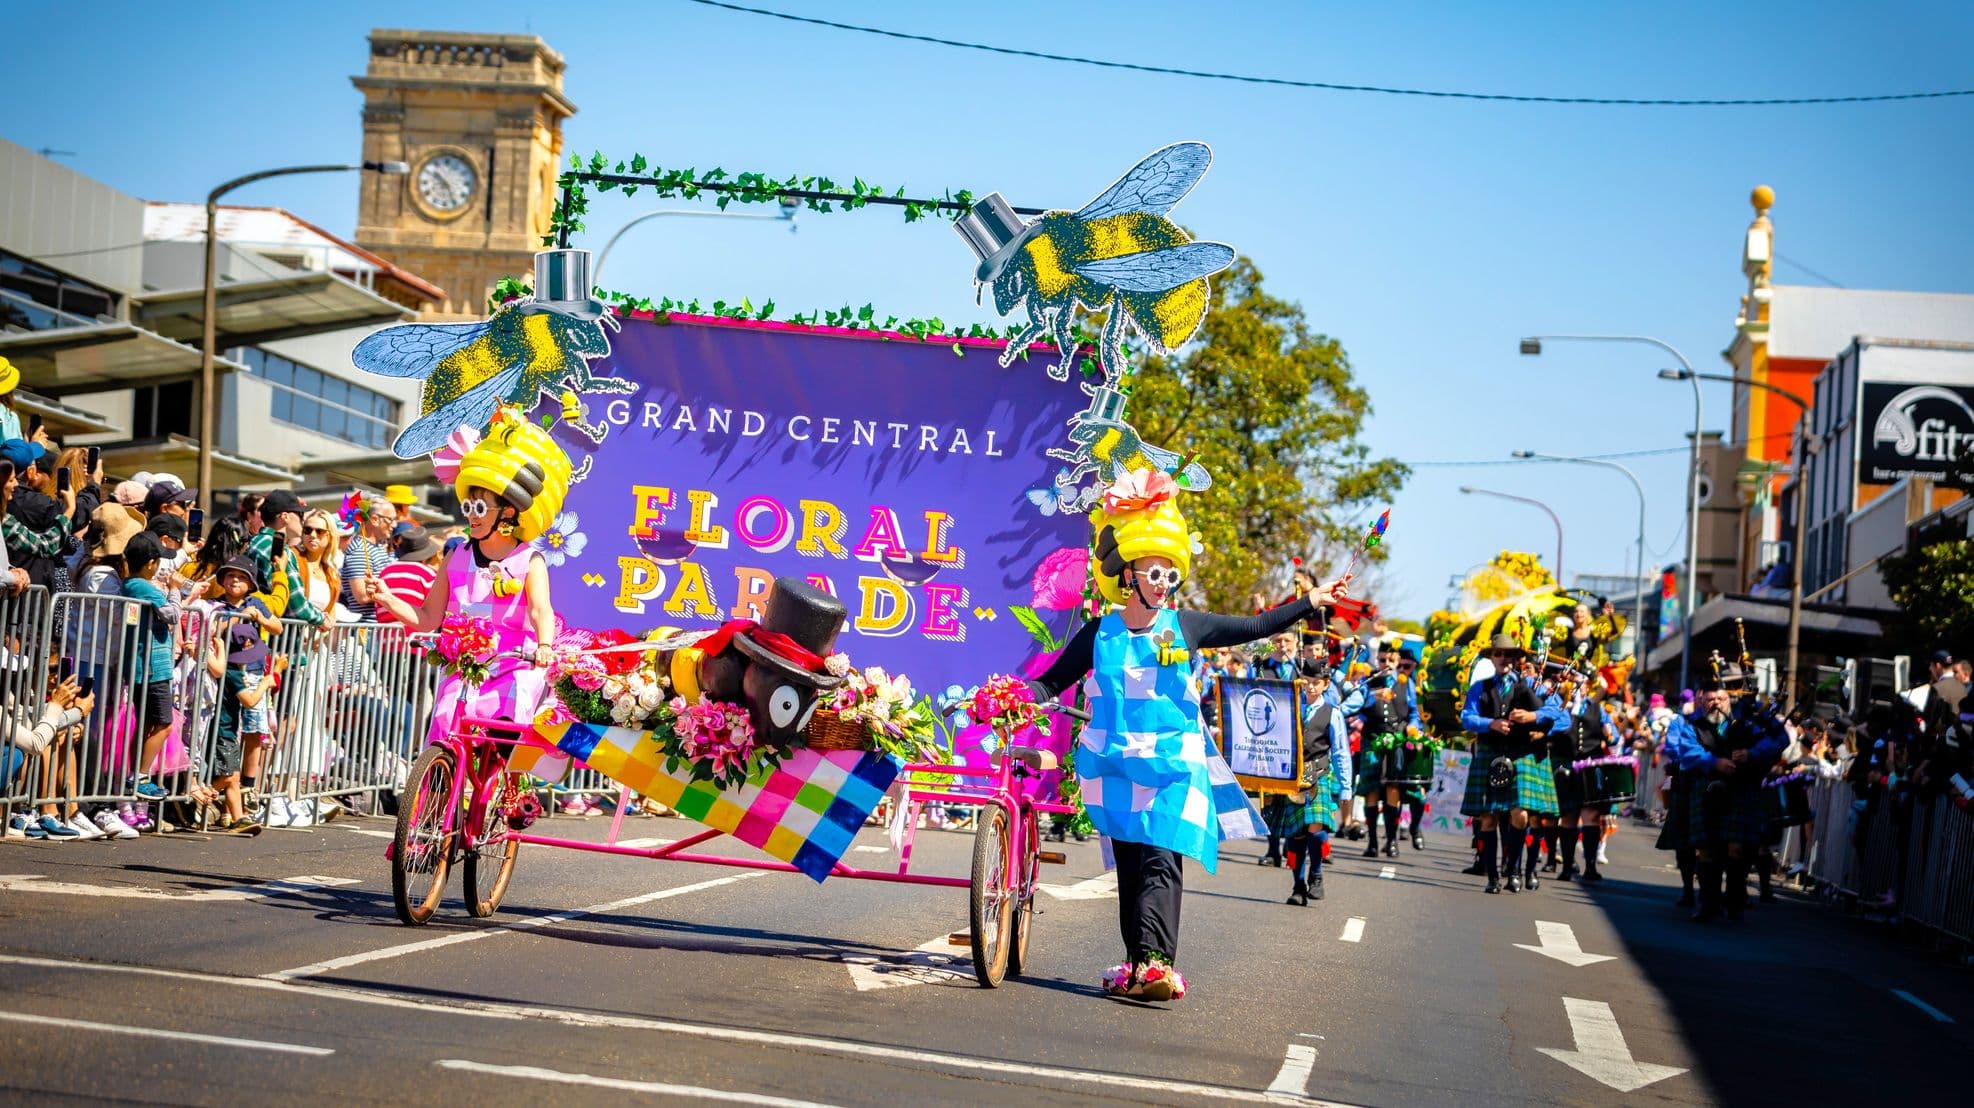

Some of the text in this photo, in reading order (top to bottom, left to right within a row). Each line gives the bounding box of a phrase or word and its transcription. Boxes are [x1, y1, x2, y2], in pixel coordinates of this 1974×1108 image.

[606, 399, 1004, 457] GRAND CENTRAL
[628, 485, 965, 569] FLORAL
